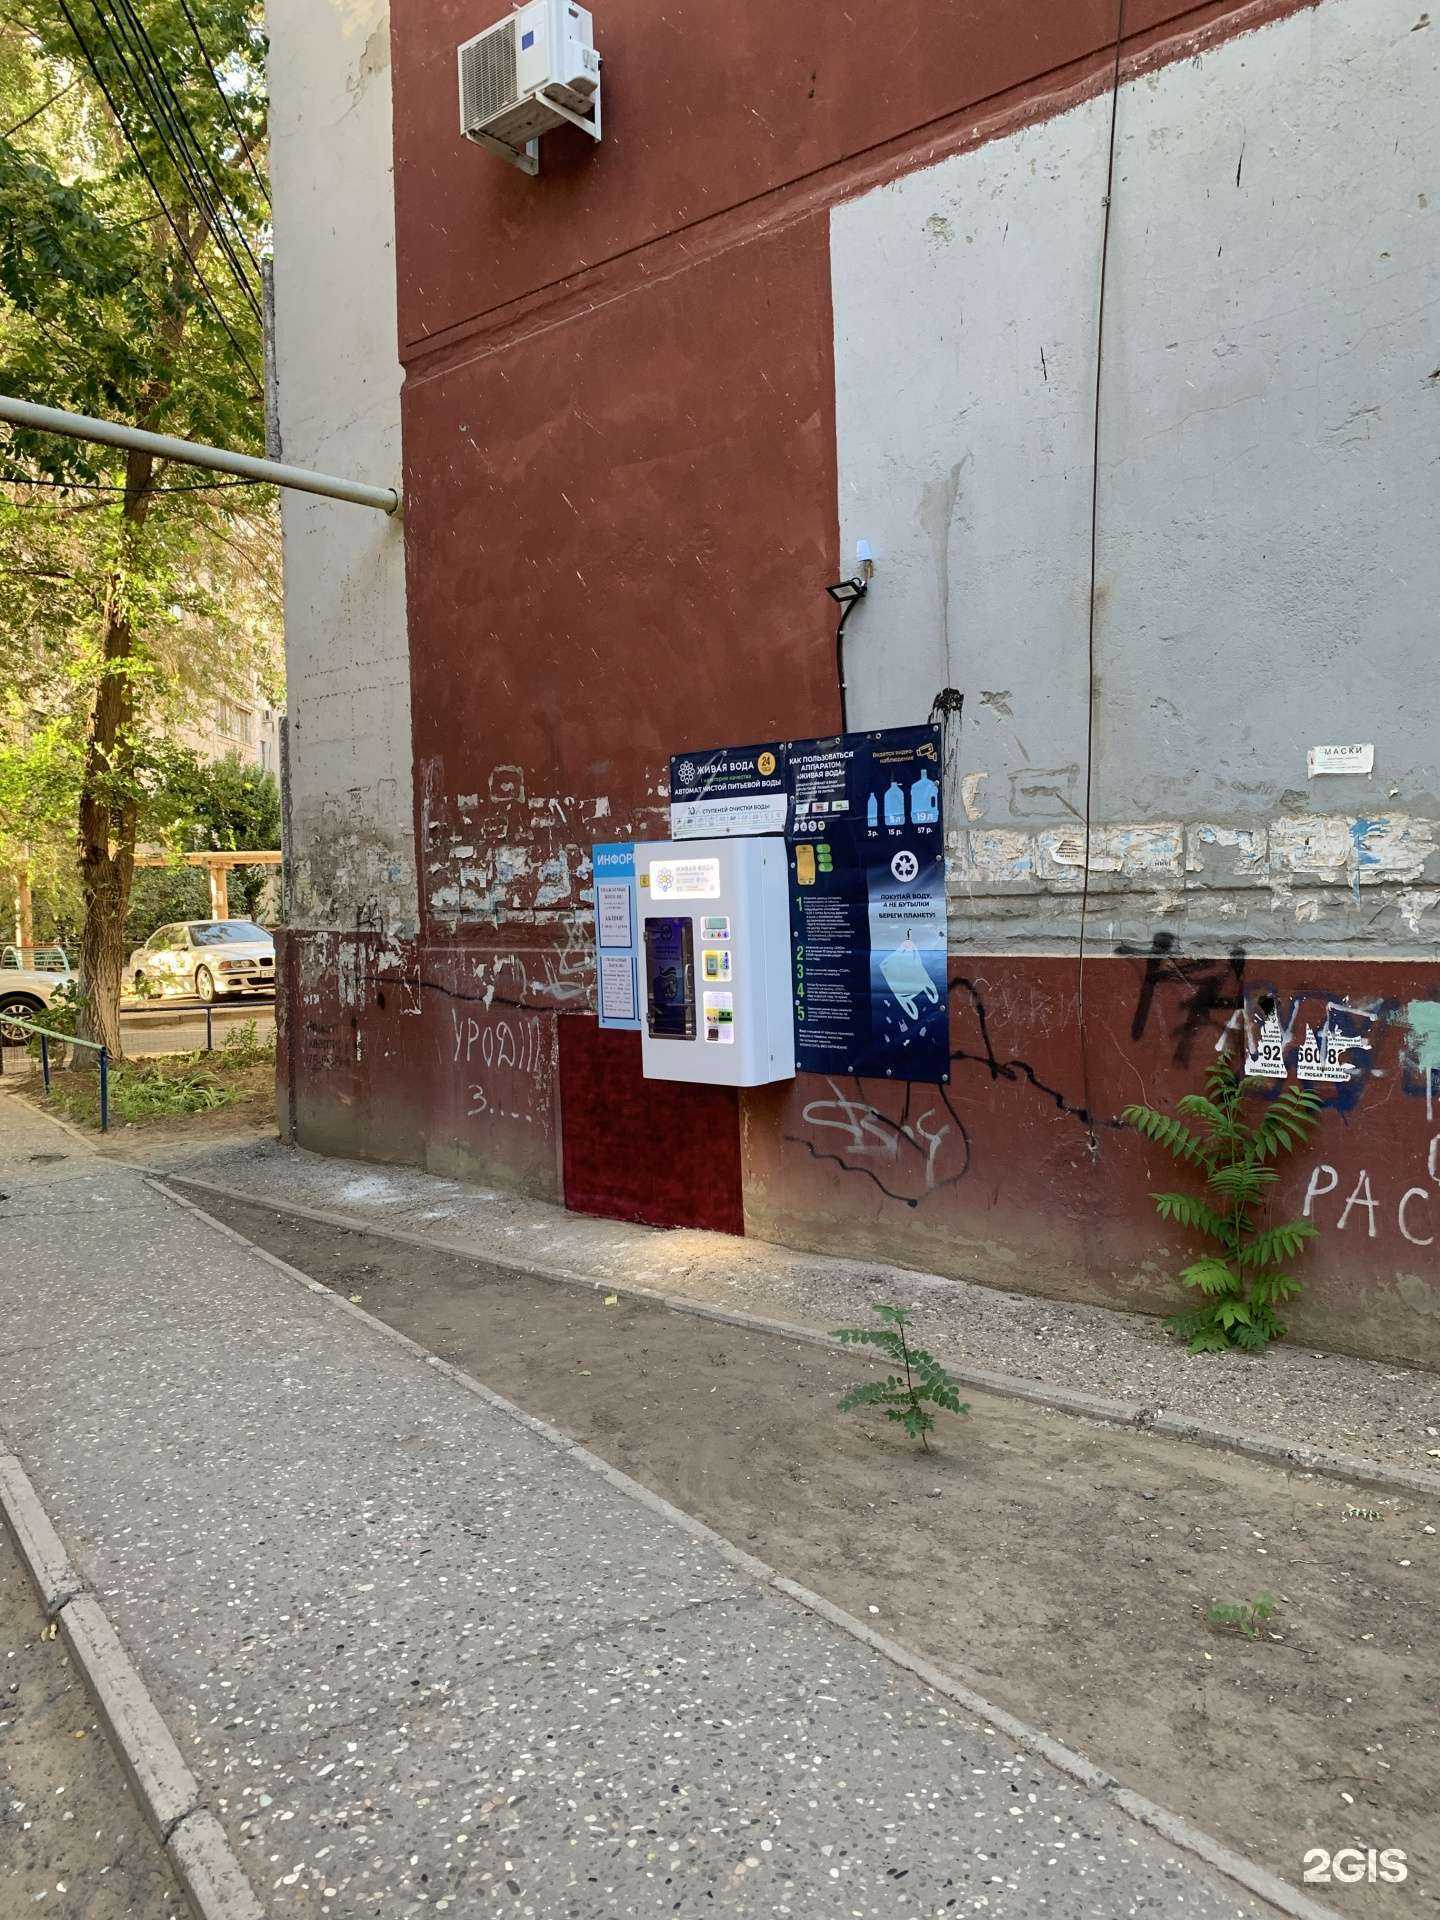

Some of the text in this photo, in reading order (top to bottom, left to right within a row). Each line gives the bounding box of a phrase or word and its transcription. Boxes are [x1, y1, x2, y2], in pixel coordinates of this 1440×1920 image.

[1325, 746, 1362, 755] МАСКИ
[761, 756, 770, 766] 24
[789, 751, 854, 765] КАК ПОЛЬЗОВАТЬСЯ
[697, 761, 755, 775] ЖИВАЯ ВОДА
[801, 761, 841, 771] АППАРАТОМ
[674, 786, 702, 795] АВТОМАТ
[728, 780, 761, 790] ПИТЬЕВОЙ
[761, 779, 782, 788] ВОДЫ
[729, 804, 753, 812] ОЧИСТКИ
[888, 828, 895, 836] 15
[880, 892, 911, 900] ПОКУПАЙ
[796, 896, 803, 912] 1
[797, 945, 804, 961] 2
[797, 963, 804, 979] 3
[797, 982, 805, 998] 4
[797, 1005, 805, 1021] 5
